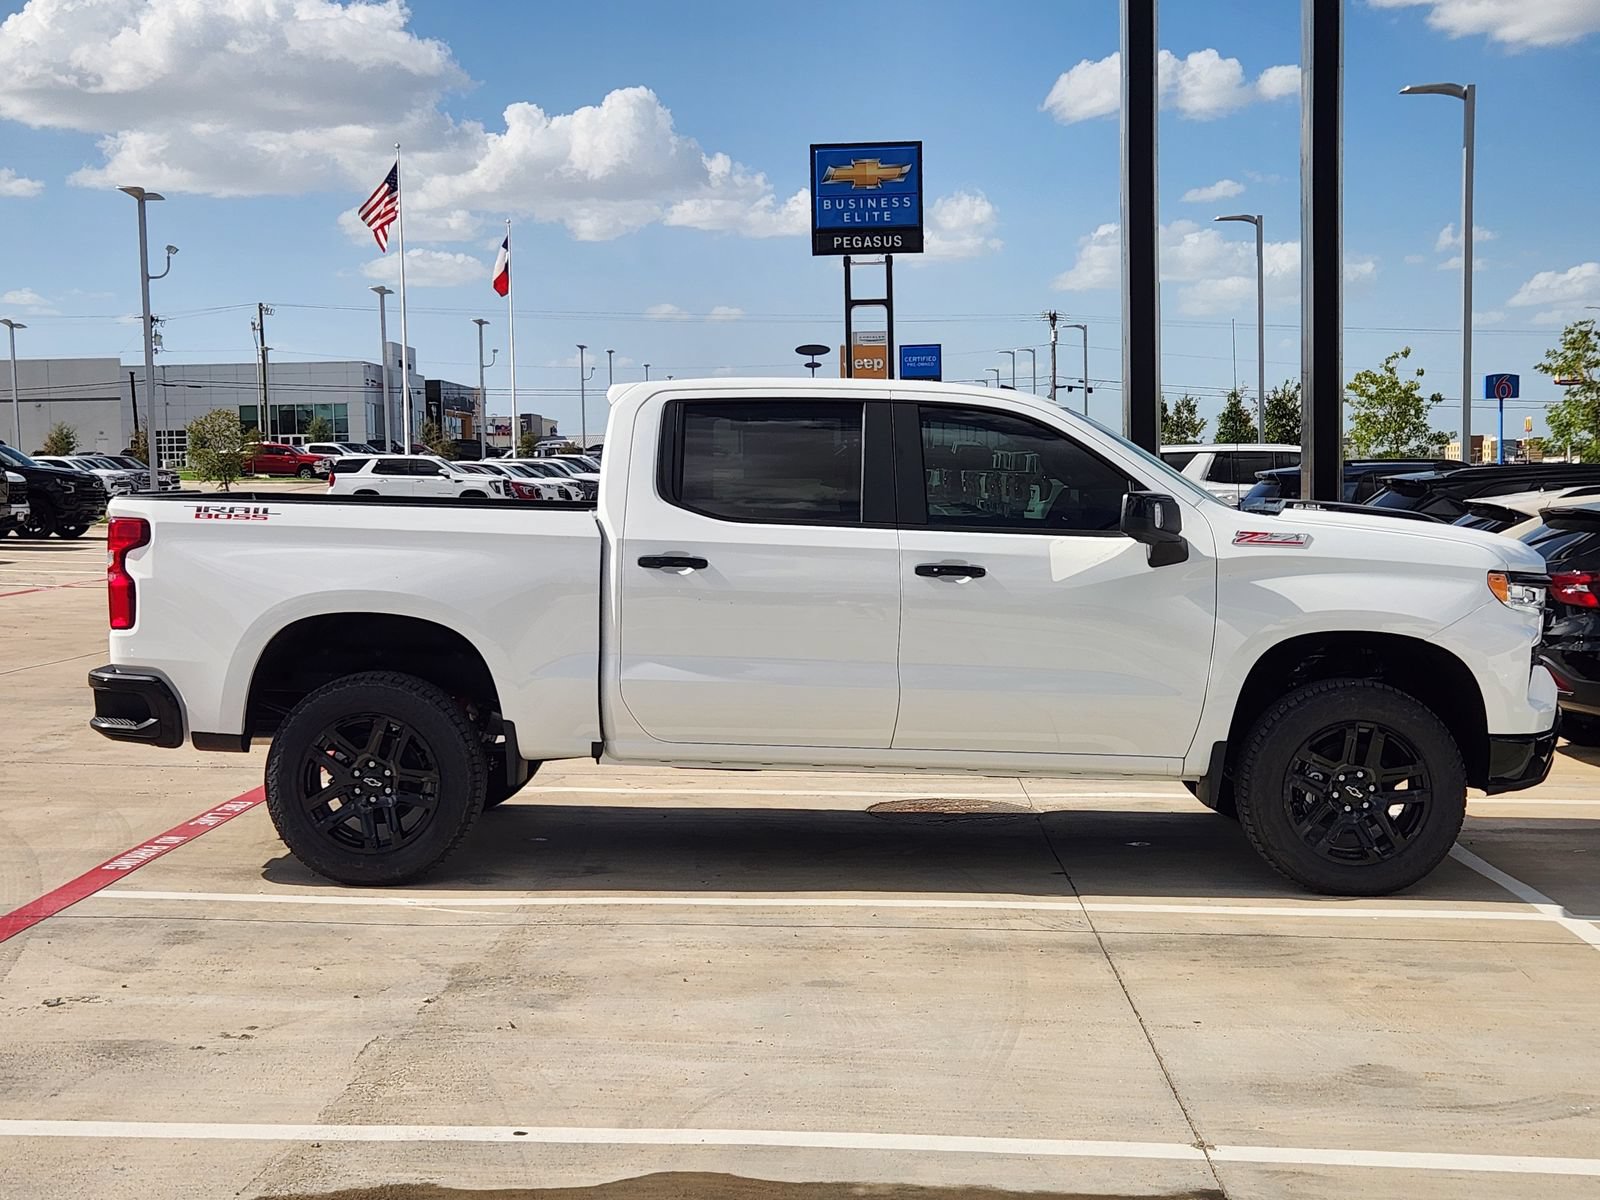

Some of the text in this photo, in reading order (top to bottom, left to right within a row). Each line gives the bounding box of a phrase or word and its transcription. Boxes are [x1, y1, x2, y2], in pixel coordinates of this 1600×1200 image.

[823, 197, 911, 210] BUSINESS
[843, 211, 891, 223] ELITE
[833, 235, 902, 249] PEGASUS
[843, 358, 884, 371] eep
[1494, 375, 1513, 400] 6
[188, 506, 277, 515] TRAIL
[195, 513, 269, 521] BOSS
